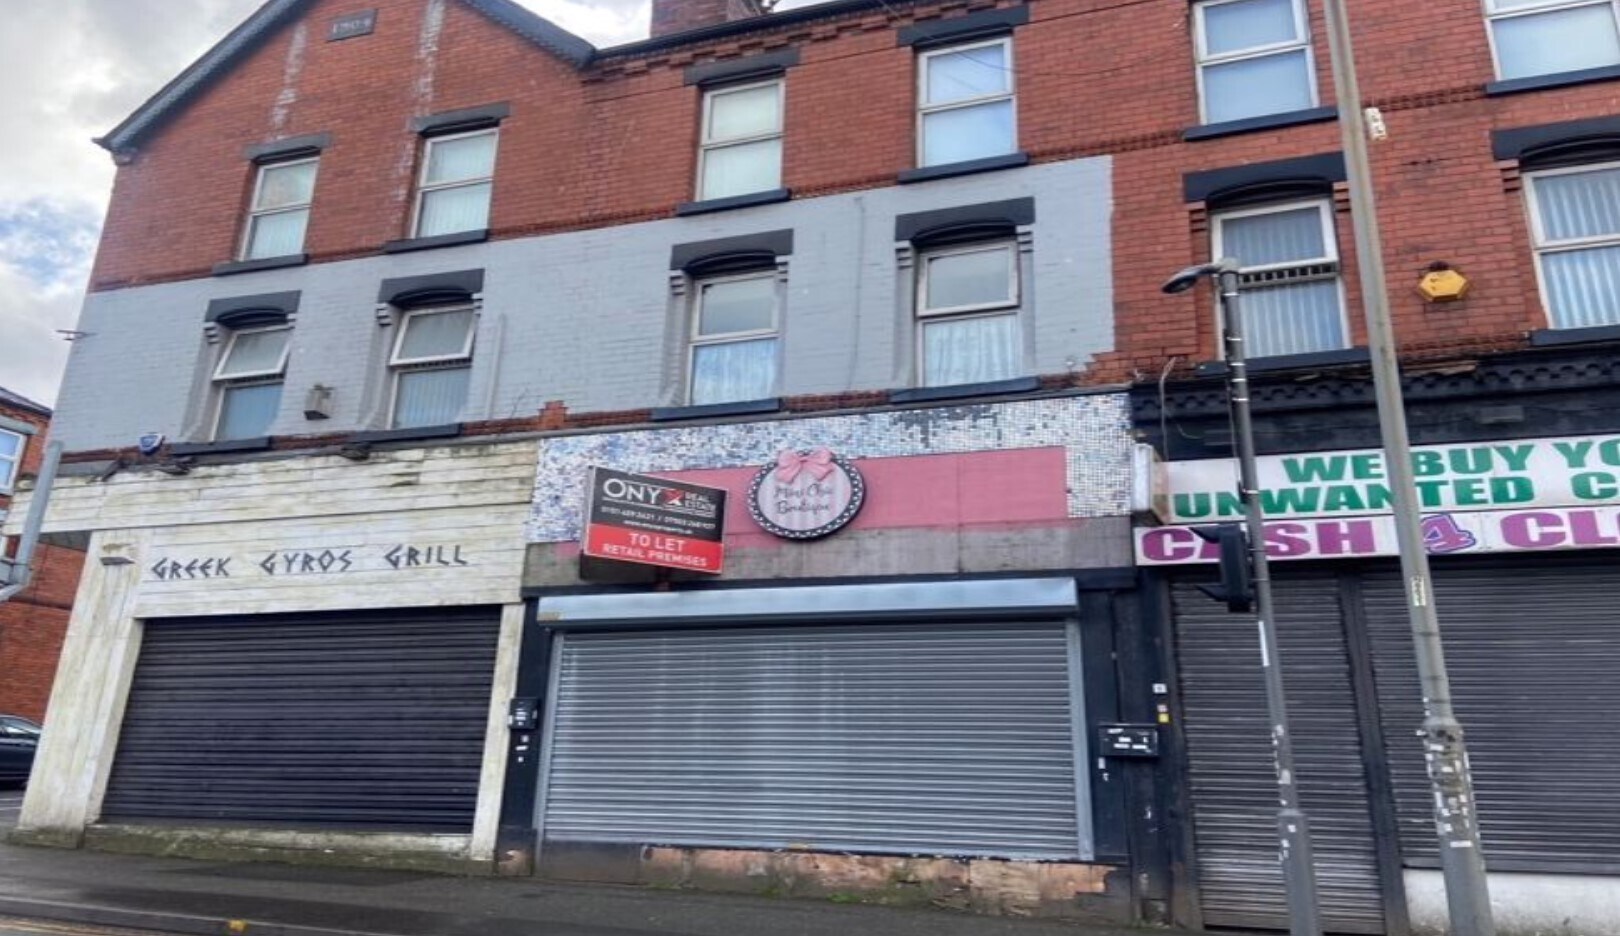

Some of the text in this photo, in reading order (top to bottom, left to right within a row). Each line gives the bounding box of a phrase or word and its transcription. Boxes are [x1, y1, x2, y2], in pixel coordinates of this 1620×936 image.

[1282, 454, 1384, 483] WE
[1411, 444, 1534, 476] BUY
[1174, 476, 1534, 518] UNWANTED
[629, 533, 685, 553] TO LET
[1141, 510, 1620, 562] CSH 4 CL
[152, 543, 468, 579] GREEK GYROS GRILL
[602, 543, 708, 567] RETAIL PREMISES
